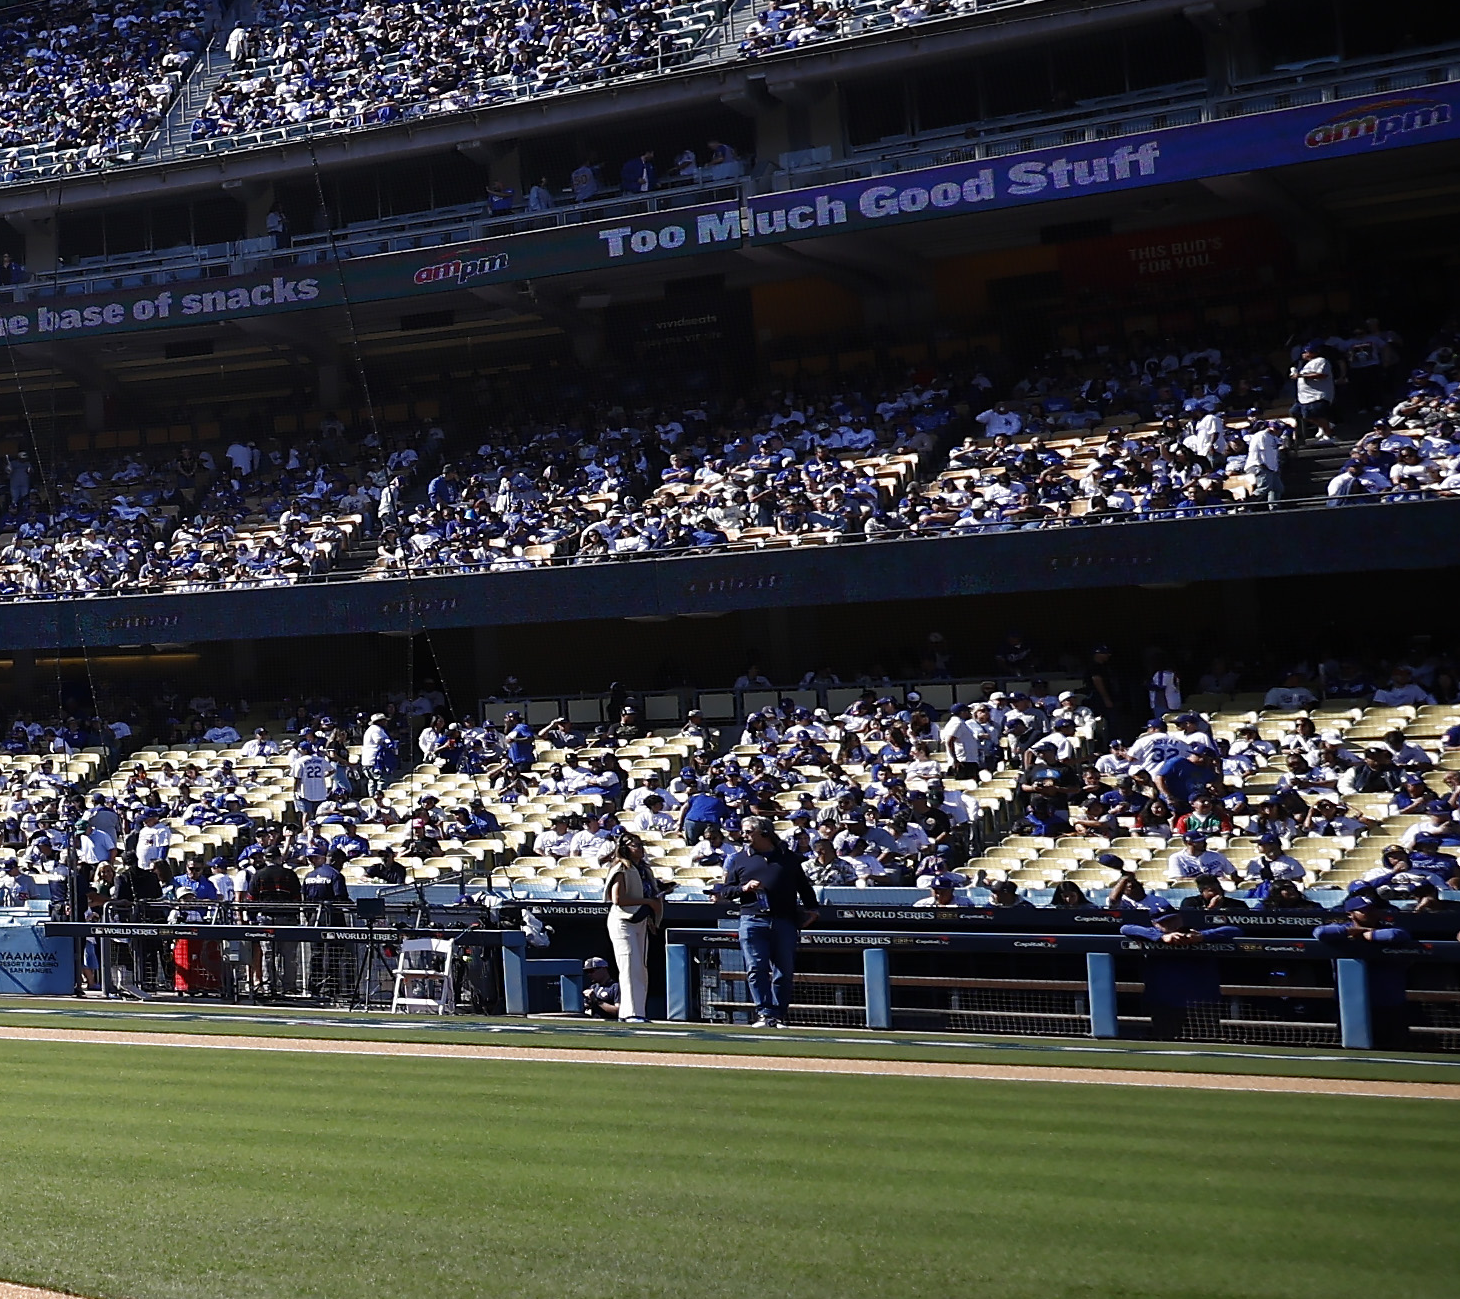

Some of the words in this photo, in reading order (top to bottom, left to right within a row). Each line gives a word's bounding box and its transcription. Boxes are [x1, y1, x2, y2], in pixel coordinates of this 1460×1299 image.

[1304, 103, 1453, 149] ampm
[598, 225, 686, 258] Too
[696, 195, 848, 246] Much
[858, 168, 996, 220] Good
[1006, 141, 1161, 196] Stuff
[413, 252, 511, 285] ampm
[37, 302, 126, 333] base
[131, 290, 174, 319] of
[179, 276, 320, 316] snacks
[1151, 748, 1180, 763] 32
[306, 766, 322, 779] 22
[541, 906, 576, 915] WORLD
[577, 906, 609, 915] SERIES
[854, 910, 896, 919] WORLD
[896, 911, 935, 920] SERIES
[1227, 916, 1276, 925] WORLD
[1276, 917, 1323, 926] SERIES
[103, 927, 131, 936] WORLD
[131, 928, 159, 937] SERIES
[335, 932, 368, 941] WORLD
[812, 935, 853, 944] WORLD
[853, 936, 891, 945] SERIES
[1143, 942, 1189, 951] WORLD
[1189, 943, 1235, 953] SERIES
